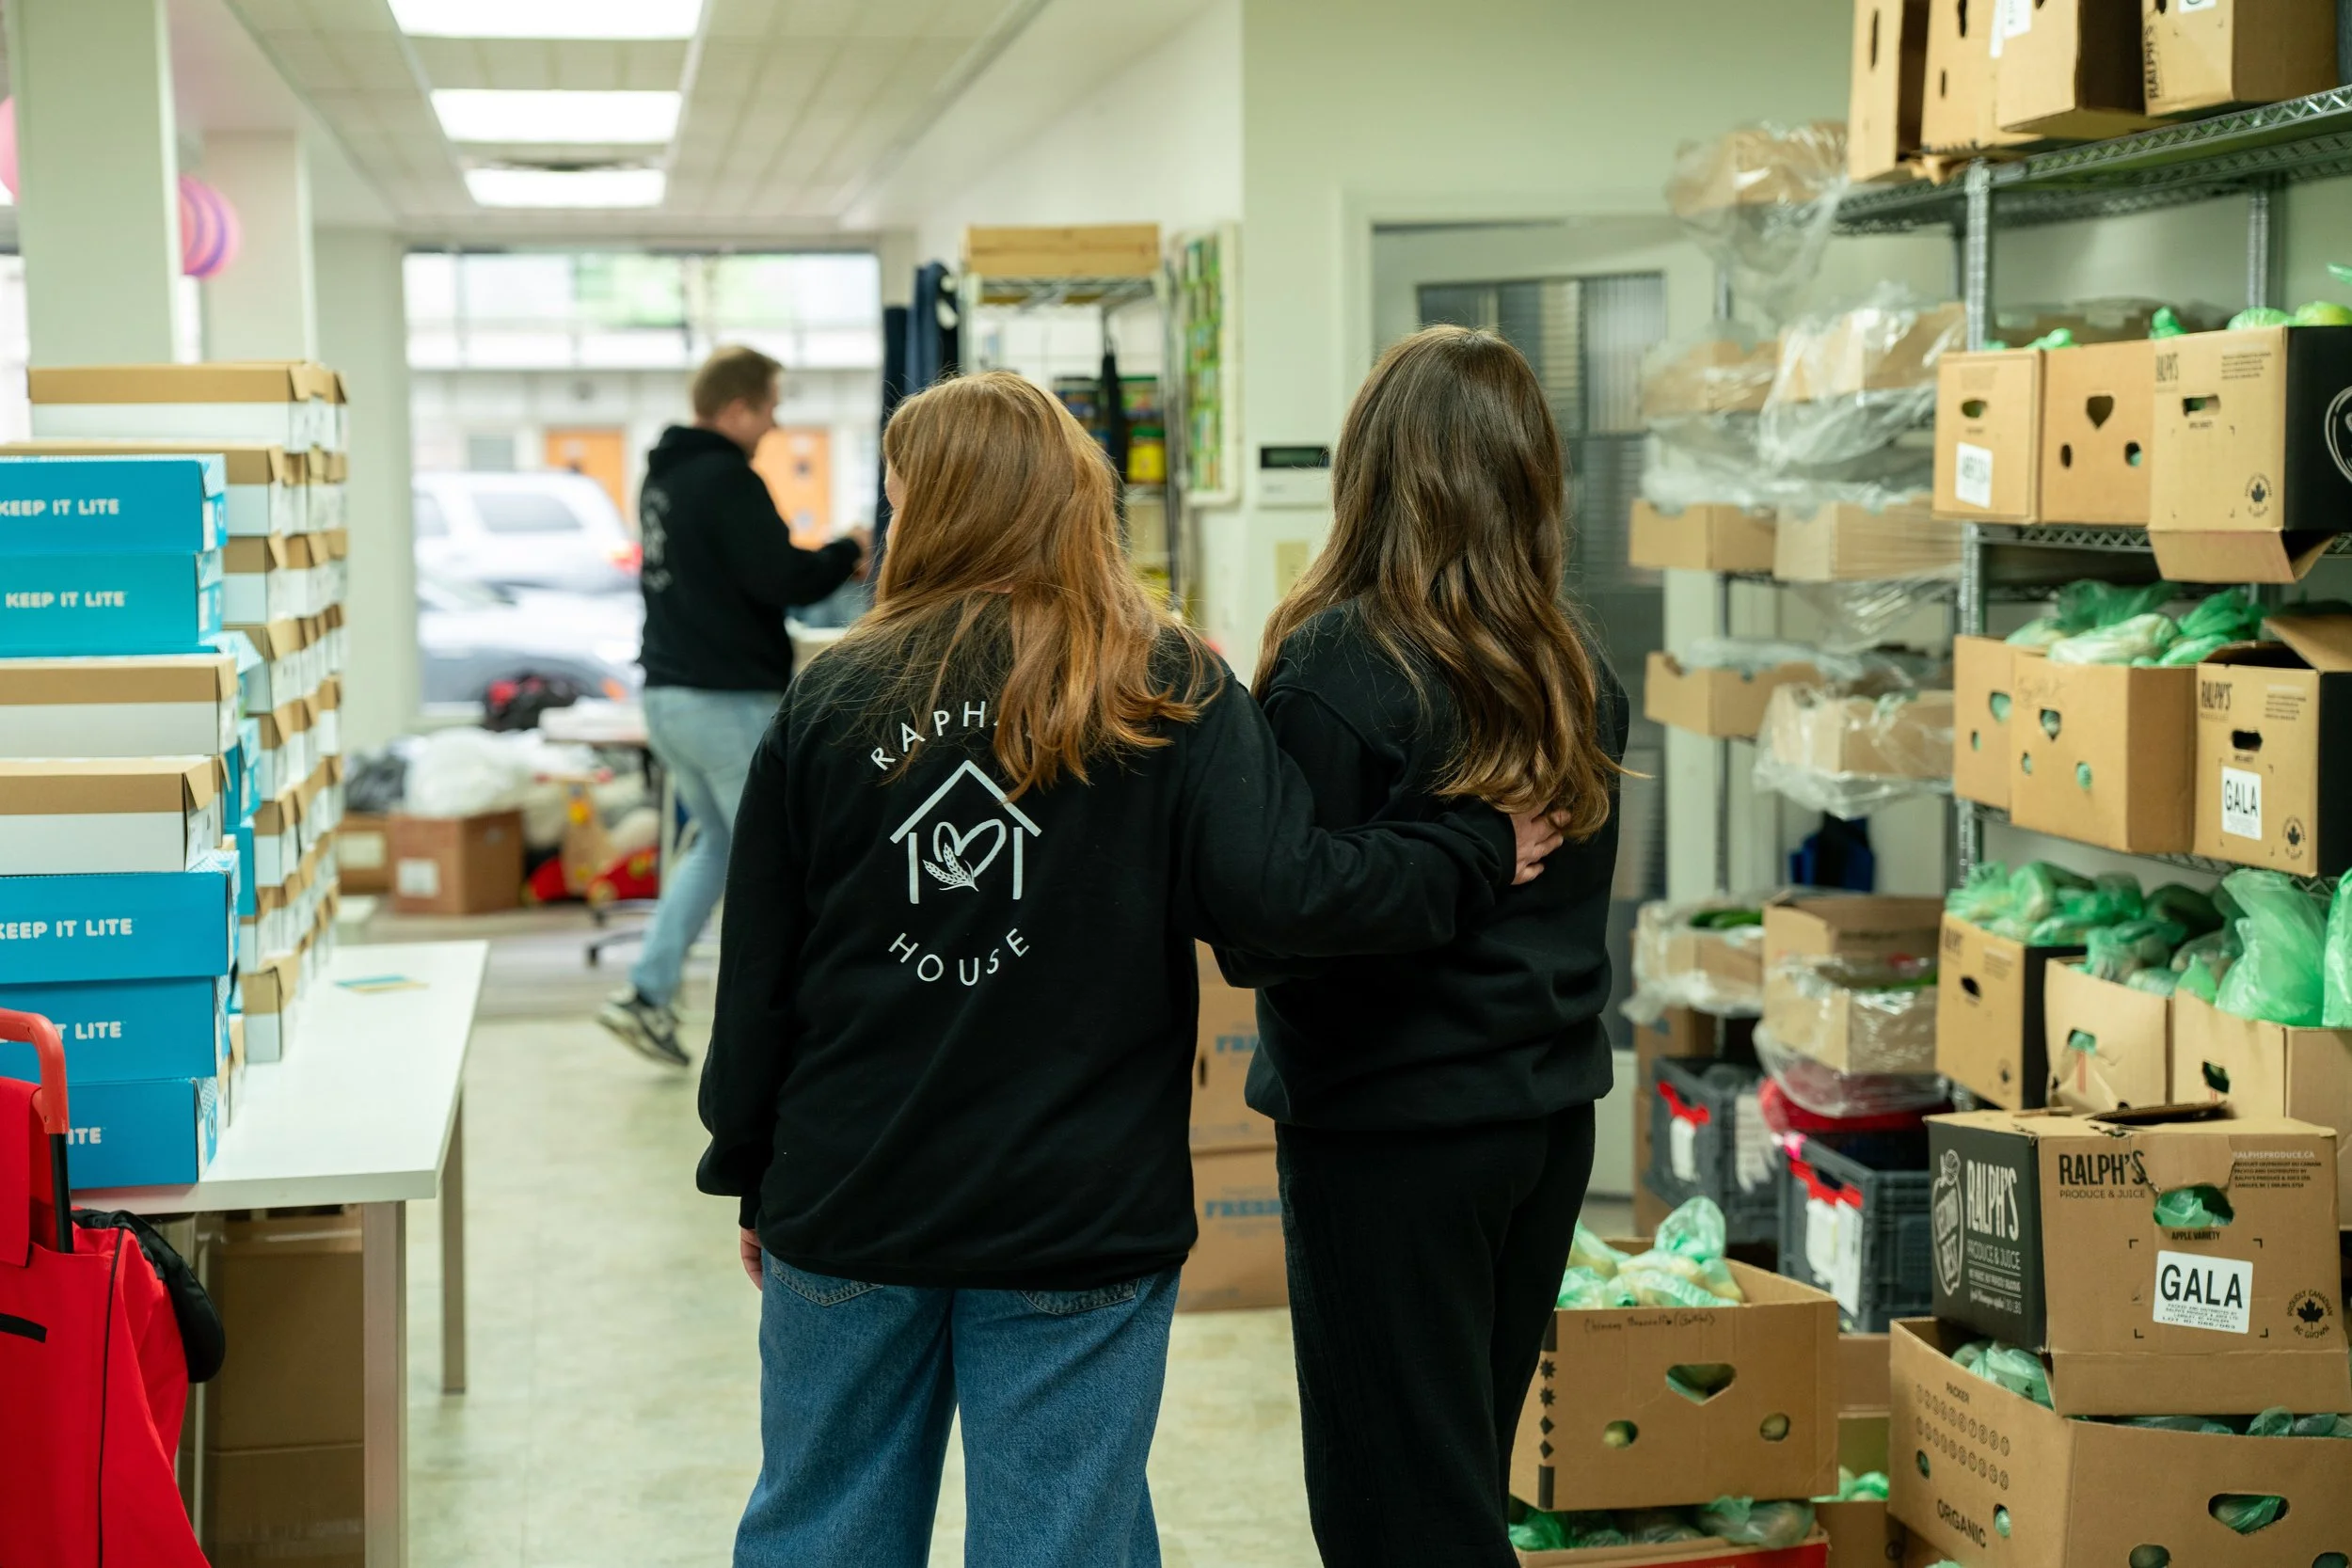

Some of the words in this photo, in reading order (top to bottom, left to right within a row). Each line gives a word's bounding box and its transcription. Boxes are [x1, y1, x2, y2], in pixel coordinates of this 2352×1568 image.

[0, 499, 46, 516] KEEP
[53, 499, 72, 516] IT
[78, 499, 119, 515] LITE
[6, 592, 55, 609] KEEP
[60, 592, 79, 608] IT
[85, 591, 125, 608] LITE
[871, 701, 999, 771] RAPH
[2224, 779, 2258, 818] GALA
[56, 920, 77, 938] IT
[86, 918, 133, 937] LITE
[888, 932, 1030, 986] HOUSE
[54, 1023, 67, 1040] T
[75, 1021, 122, 1040] LITE
[66, 1127, 102, 1146] ITE
[2058, 1149, 2146, 1185] RALPH'S
[1966, 1159, 2020, 1242] RALPH'S
[2059, 1189, 2106, 1199] PRODUCE
[2107, 1190, 2116, 1199] &
[2117, 1188, 2145, 1199] JUICE
[2171, 1231, 2191, 1241] APPLE
[2193, 1230, 2221, 1241] VARIETY
[2160, 1263, 2243, 1309] GALA
[2287, 1290, 2306, 1317] PROUDLY
[2309, 1289, 2333, 1317] CANADIAN
[2293, 1324, 2304, 1336] BC
[2305, 1323, 2330, 1338] GROWN
[1946, 1381, 1970, 1404] PACKER
[1936, 1498, 1986, 1549] ORGANIC
